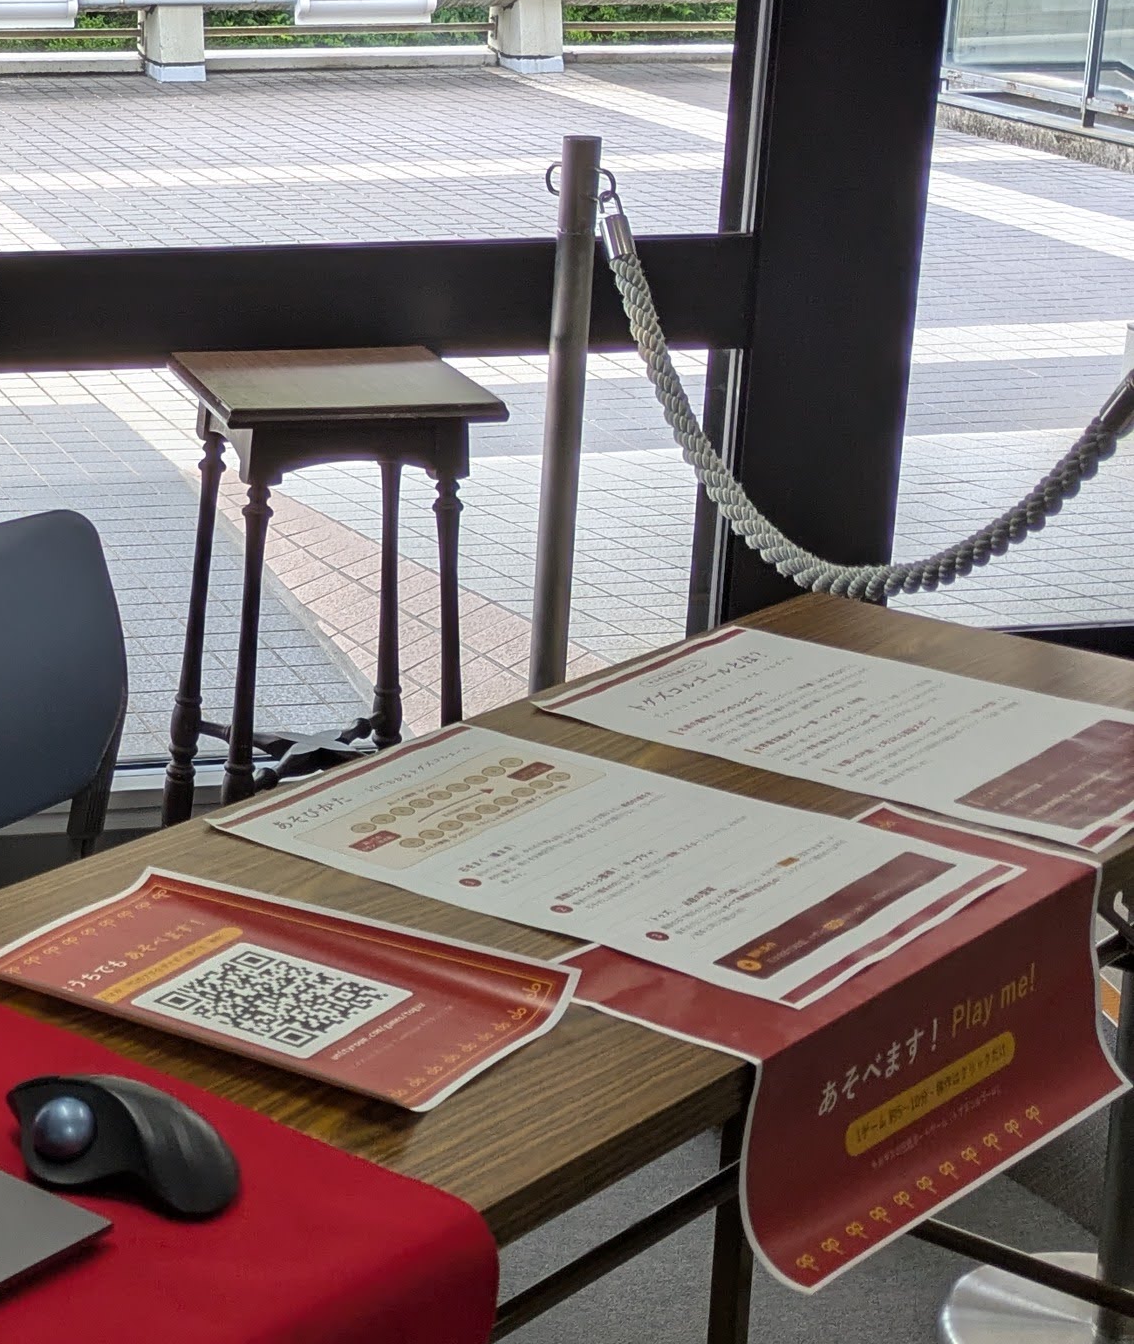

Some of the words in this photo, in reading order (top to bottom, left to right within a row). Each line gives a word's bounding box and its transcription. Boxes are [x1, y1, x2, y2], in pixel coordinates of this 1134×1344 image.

[272, 796, 353, 830] あそびかた
[818, 1017, 940, 1117] あそべます！
[951, 993, 994, 1039] Play
[1000, 961, 1036, 1009] me!
